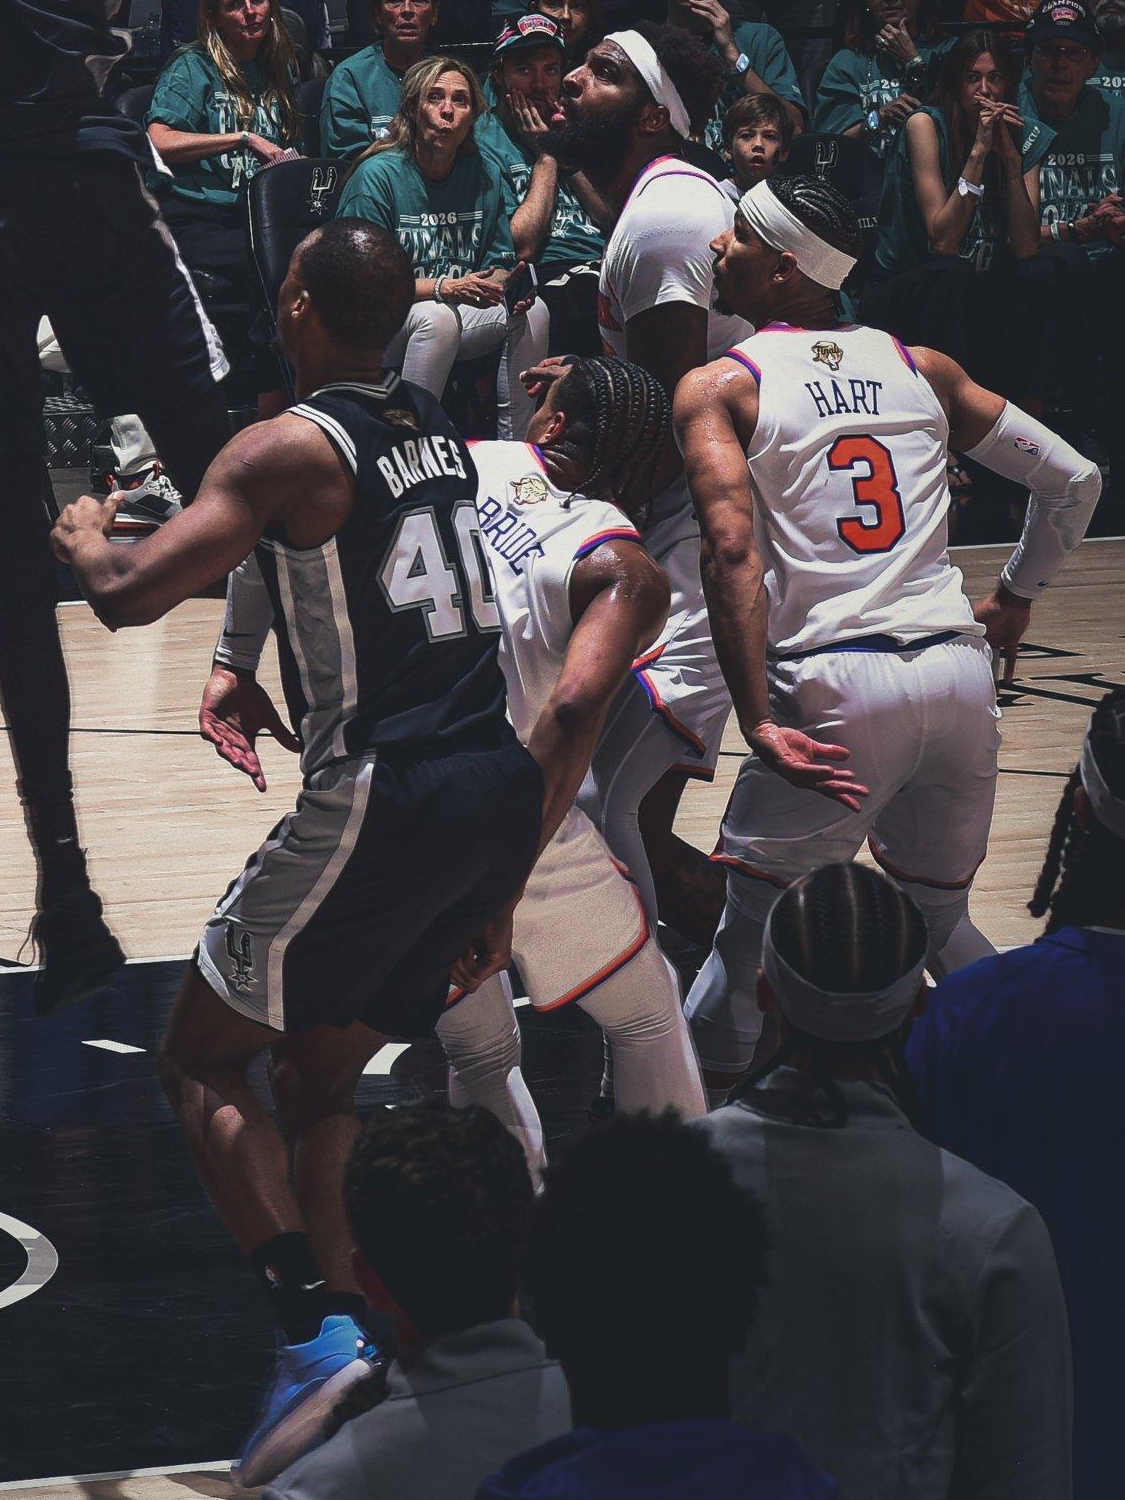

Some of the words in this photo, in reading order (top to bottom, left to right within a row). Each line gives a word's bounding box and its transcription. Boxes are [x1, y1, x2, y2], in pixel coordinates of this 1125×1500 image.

[1048, 153, 1086, 166] 2026
[1039, 164, 1121, 202] INALS
[421, 211, 457, 226] 2026
[397, 226, 483, 266] FINALS
[806, 380, 882, 419] HART
[377, 436, 467, 499] BARNES
[826, 434, 906, 555] 3
[477, 497, 546, 578] BRIDE
[376, 500, 503, 646] 40
